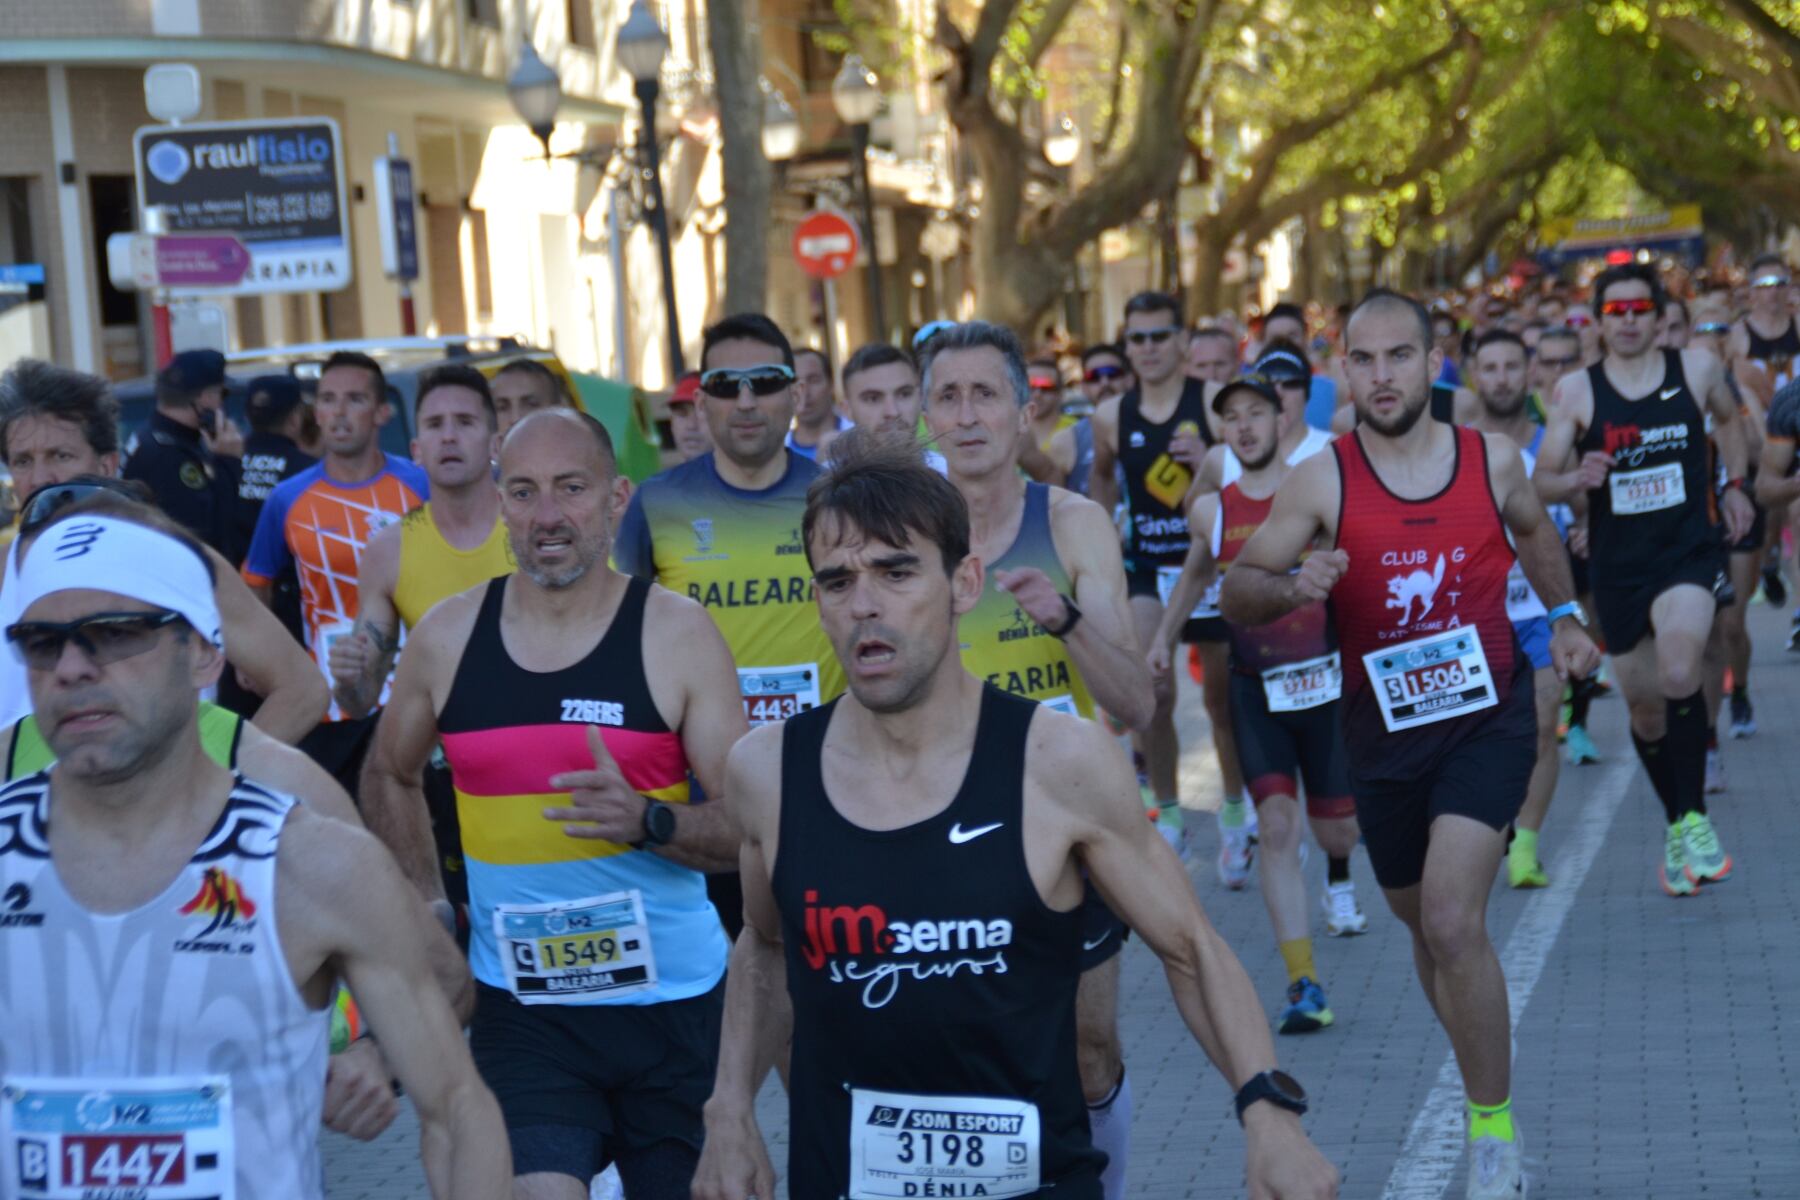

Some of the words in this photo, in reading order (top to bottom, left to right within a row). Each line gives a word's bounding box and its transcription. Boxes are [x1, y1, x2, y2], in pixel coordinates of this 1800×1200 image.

[193, 132, 331, 170] raulfisio
[1381, 550, 1428, 566] CLUB
[1387, 679, 1401, 699] S
[1407, 664, 1466, 696] 1506
[560, 699, 624, 726] 226ERS
[802, 889, 888, 971] jm
[888, 917, 1013, 954] serna
[543, 938, 617, 969] 1549
[829, 951, 1009, 1009] seguros
[911, 1111, 950, 1130] SOM
[955, 1115, 1022, 1133] ESPORT
[21, 1141, 47, 1181] B
[66, 1142, 184, 1186] 1447
[897, 1131, 985, 1168] 3198
[903, 1177, 989, 1197] DÉNIA
